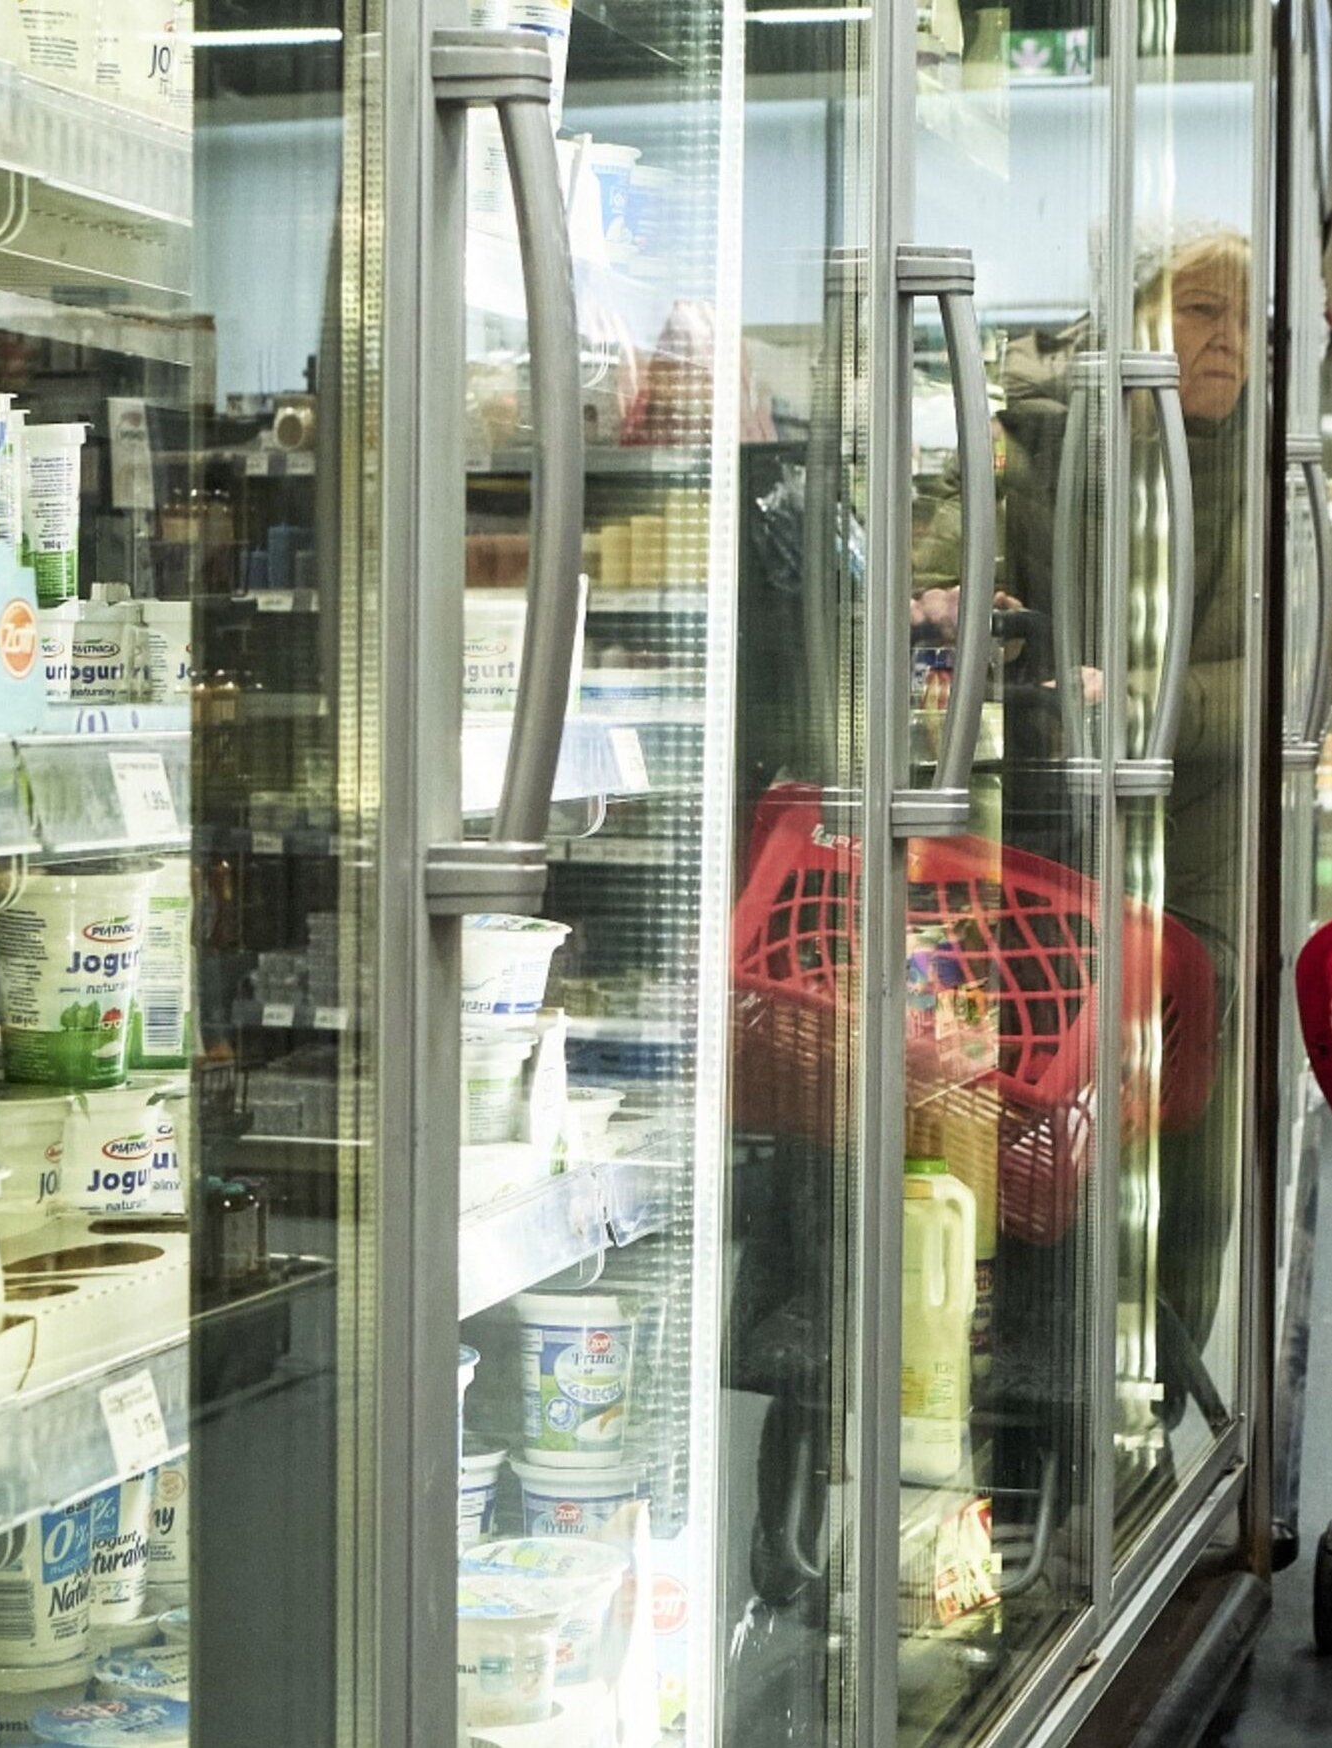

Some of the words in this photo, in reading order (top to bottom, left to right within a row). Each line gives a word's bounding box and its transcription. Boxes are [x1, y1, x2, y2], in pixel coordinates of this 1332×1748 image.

[2, 623, 36, 653] Zott
[91, 924, 135, 938] PIĄTNIC
[66, 951, 140, 978] Jogur
[87, 983, 125, 995] natura
[110, 1141, 152, 1155] PIĄTNIC
[86, 1169, 151, 1195] Jogu
